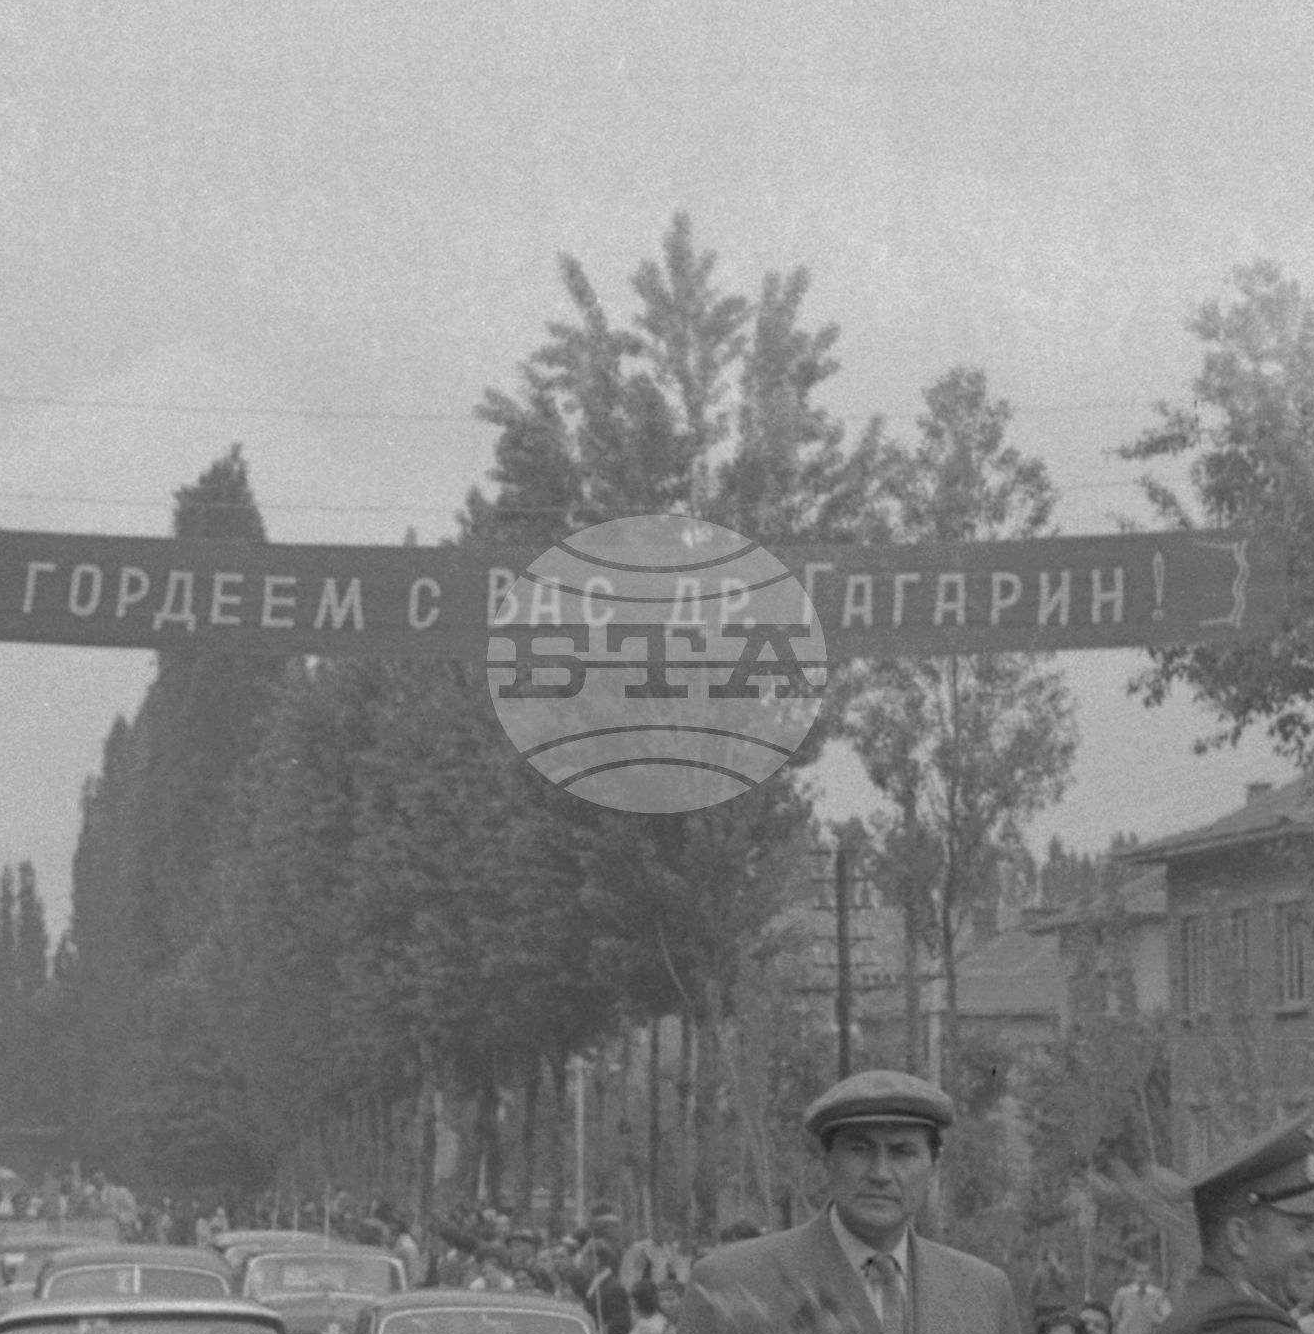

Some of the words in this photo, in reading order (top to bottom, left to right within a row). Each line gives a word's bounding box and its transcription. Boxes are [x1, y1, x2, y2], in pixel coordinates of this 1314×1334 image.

[22, 560, 366, 632] ГОРДЕЕМ
[406, 577, 442, 631] С
[487, 566, 615, 628] ВАС
